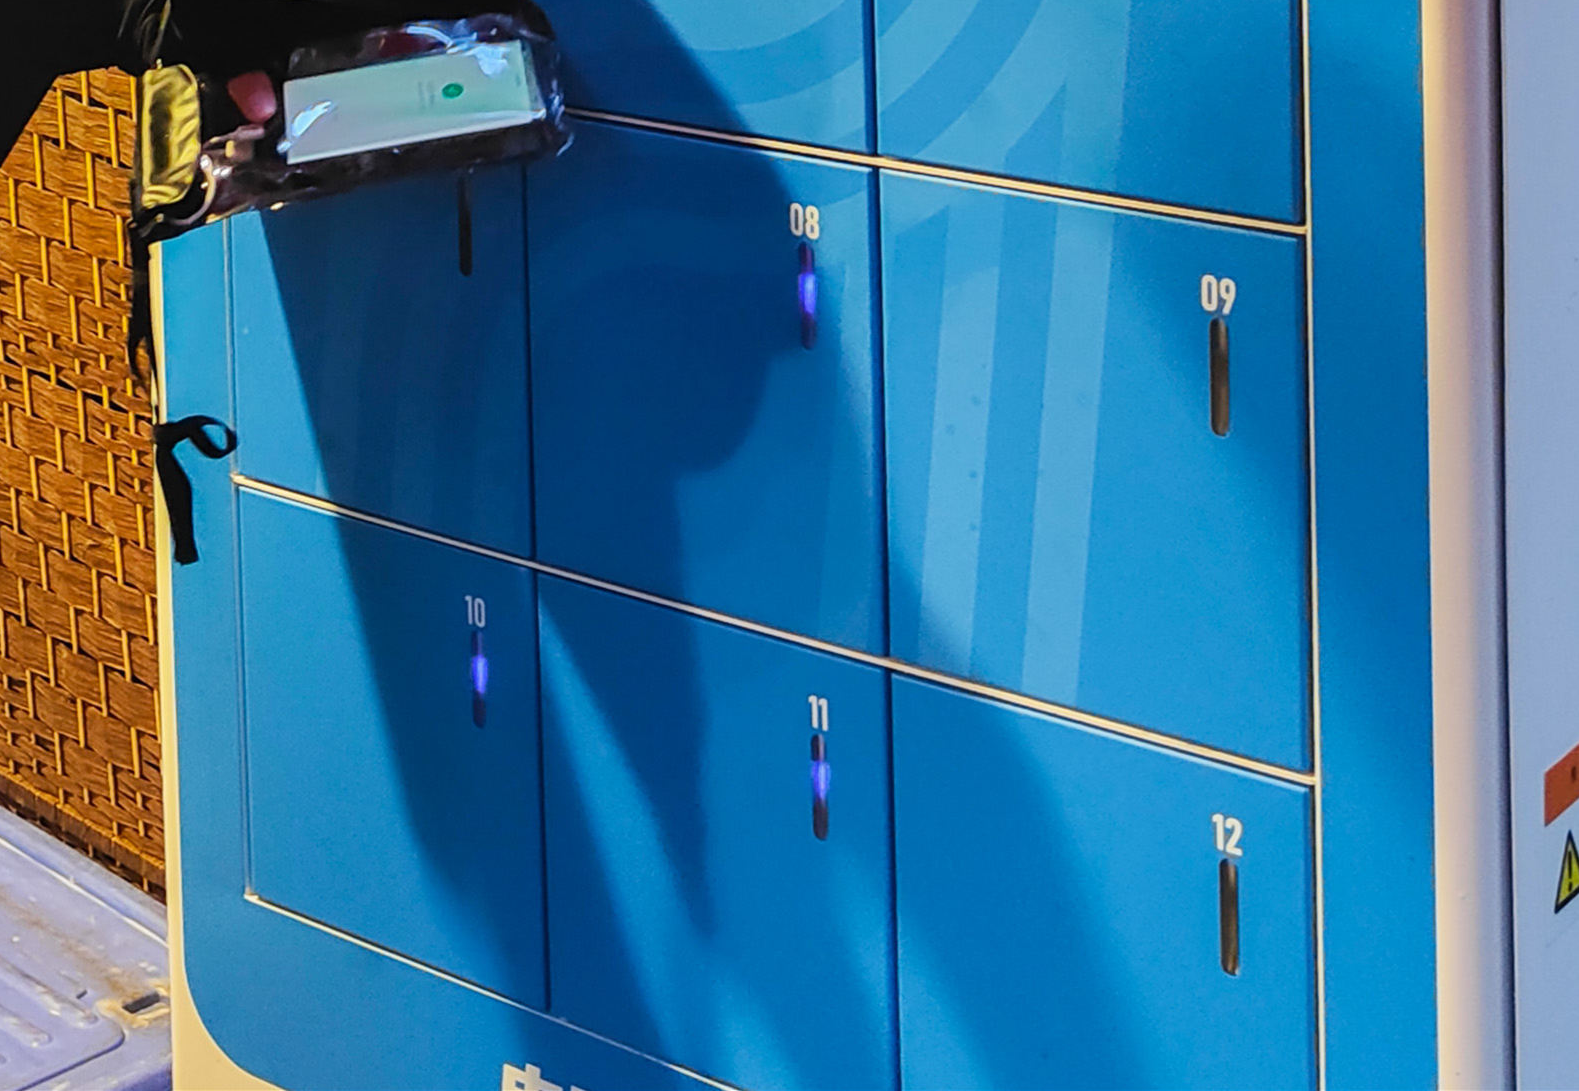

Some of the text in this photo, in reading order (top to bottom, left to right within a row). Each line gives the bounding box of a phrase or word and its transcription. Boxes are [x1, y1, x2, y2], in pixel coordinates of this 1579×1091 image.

[789, 203, 820, 240] 08
[1199, 274, 1237, 315] 09
[464, 595, 487, 630] 10
[807, 694, 830, 735] 11
[1210, 813, 1244, 855] 12
